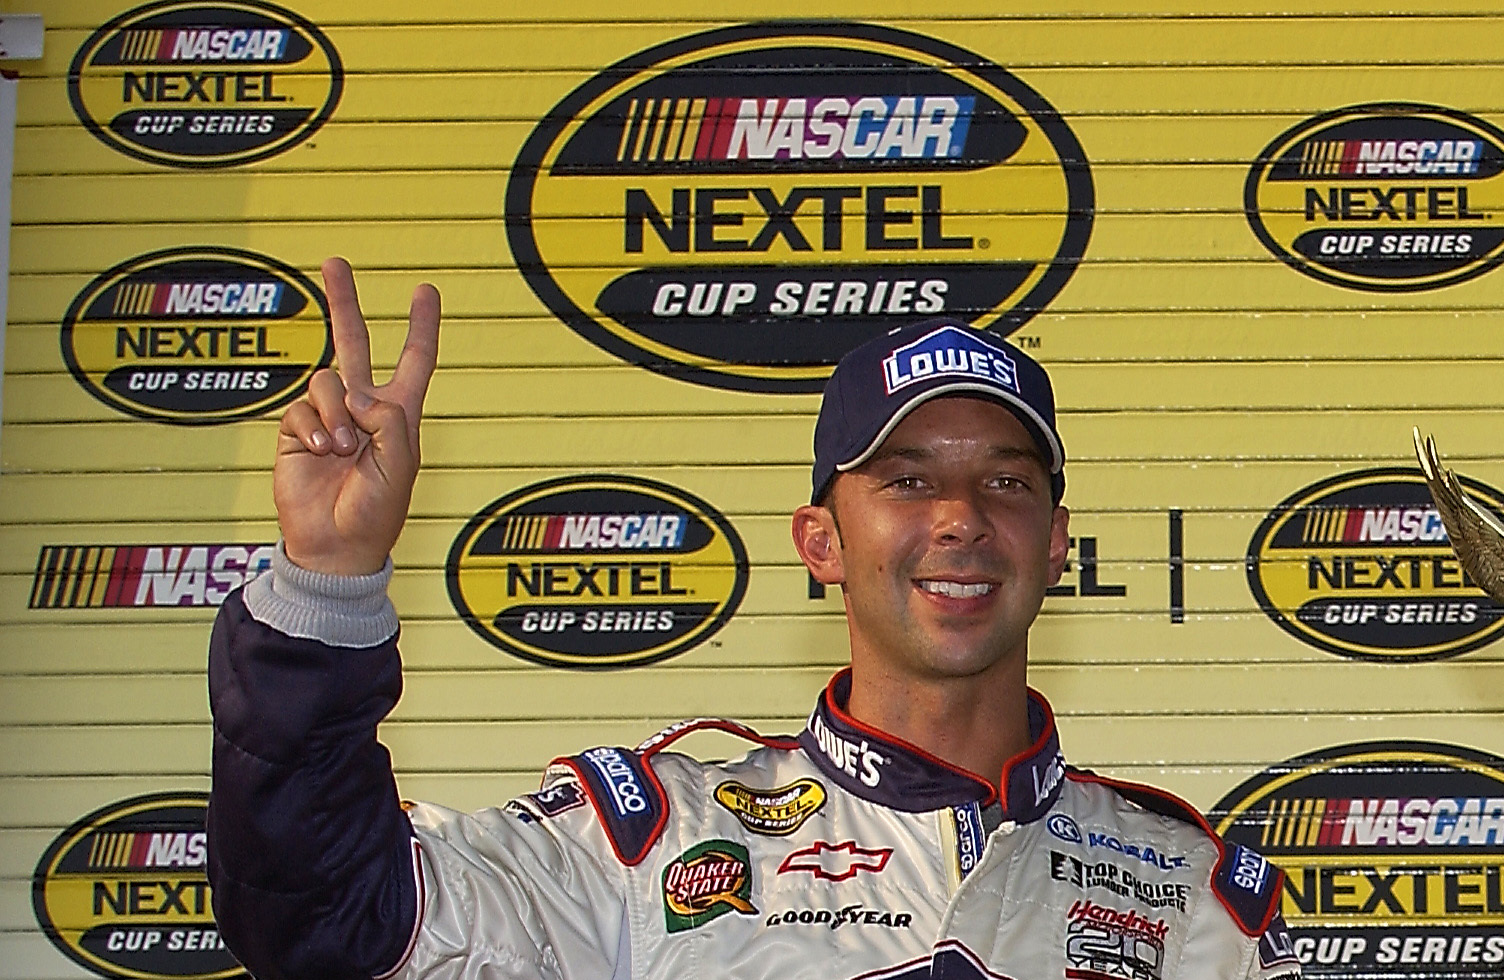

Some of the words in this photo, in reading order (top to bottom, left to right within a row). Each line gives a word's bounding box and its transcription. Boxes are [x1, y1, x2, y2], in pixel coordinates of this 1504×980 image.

[172, 30, 282, 60] NASCAR
[123, 72, 288, 102] NEXTEL
[135, 116, 183, 134] CUP
[188, 115, 274, 134] SERIES
[727, 97, 959, 159] NASCAR
[1355, 142, 1475, 174] NASCAR
[624, 186, 973, 253] NEXTEL
[1305, 187, 1484, 221] NEXTEL
[1320, 236, 1373, 254] CUP
[1380, 235, 1472, 253] SERIES
[166, 284, 275, 313] NASCAR
[652, 283, 757, 316] CUP
[770, 280, 949, 315] SERIES
[117, 328, 284, 358] NEXTEL
[128, 372, 178, 390] CUP
[184, 371, 269, 390] SERIES
[889, 348, 1012, 387] LOWE'S
[559, 516, 680, 548] NASCAR
[1359, 510, 1449, 541] NASC
[134, 547, 274, 605] NASC
[507, 563, 685, 597] NEXTEL
[522, 612, 576, 633] CUP
[582, 611, 674, 632] SERIES
[1324, 605, 1378, 625] CUP
[1385, 604, 1477, 624] SERIES
[736, 797, 806, 817] NEXTEL
[1088, 833, 1186, 870] KOBALT
[666, 861, 744, 892] QUAKER
[676, 877, 731, 902] STATE
[1084, 862, 1118, 880] TOP
[1122, 869, 1187, 900] CHOICE
[93, 882, 209, 915] NEXT
[766, 904, 912, 930] GOODYEAR
[1067, 900, 1170, 940] Hendrick
[107, 931, 162, 950] CUP
[1293, 937, 1368, 963] CUP
